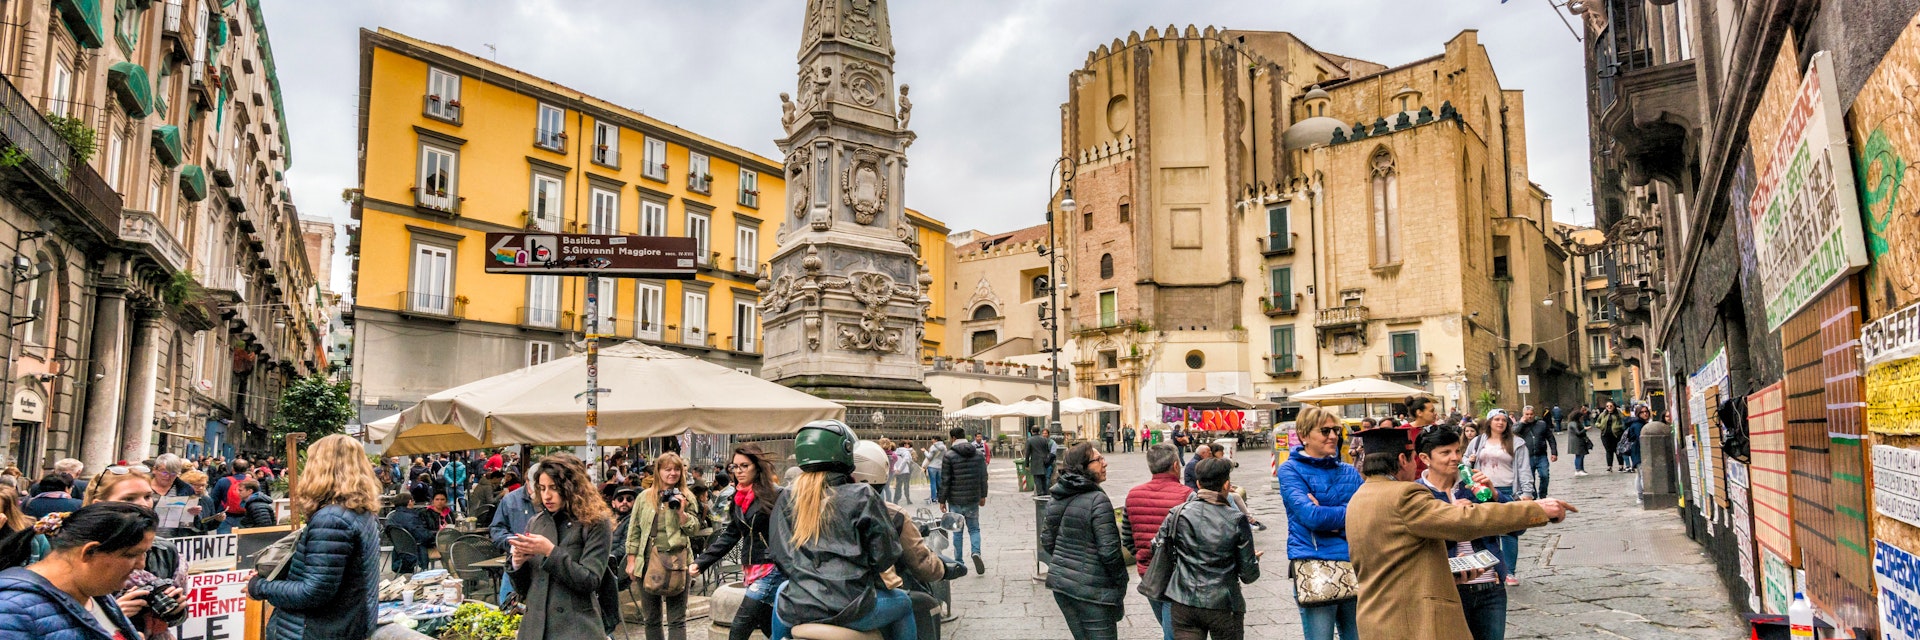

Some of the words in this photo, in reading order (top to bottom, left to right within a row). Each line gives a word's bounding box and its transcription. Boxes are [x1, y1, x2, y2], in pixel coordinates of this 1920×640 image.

[563, 237, 600, 245] Basilica
[563, 246, 614, 255] S.Giovanni
[619, 247, 661, 256] Maggiore
